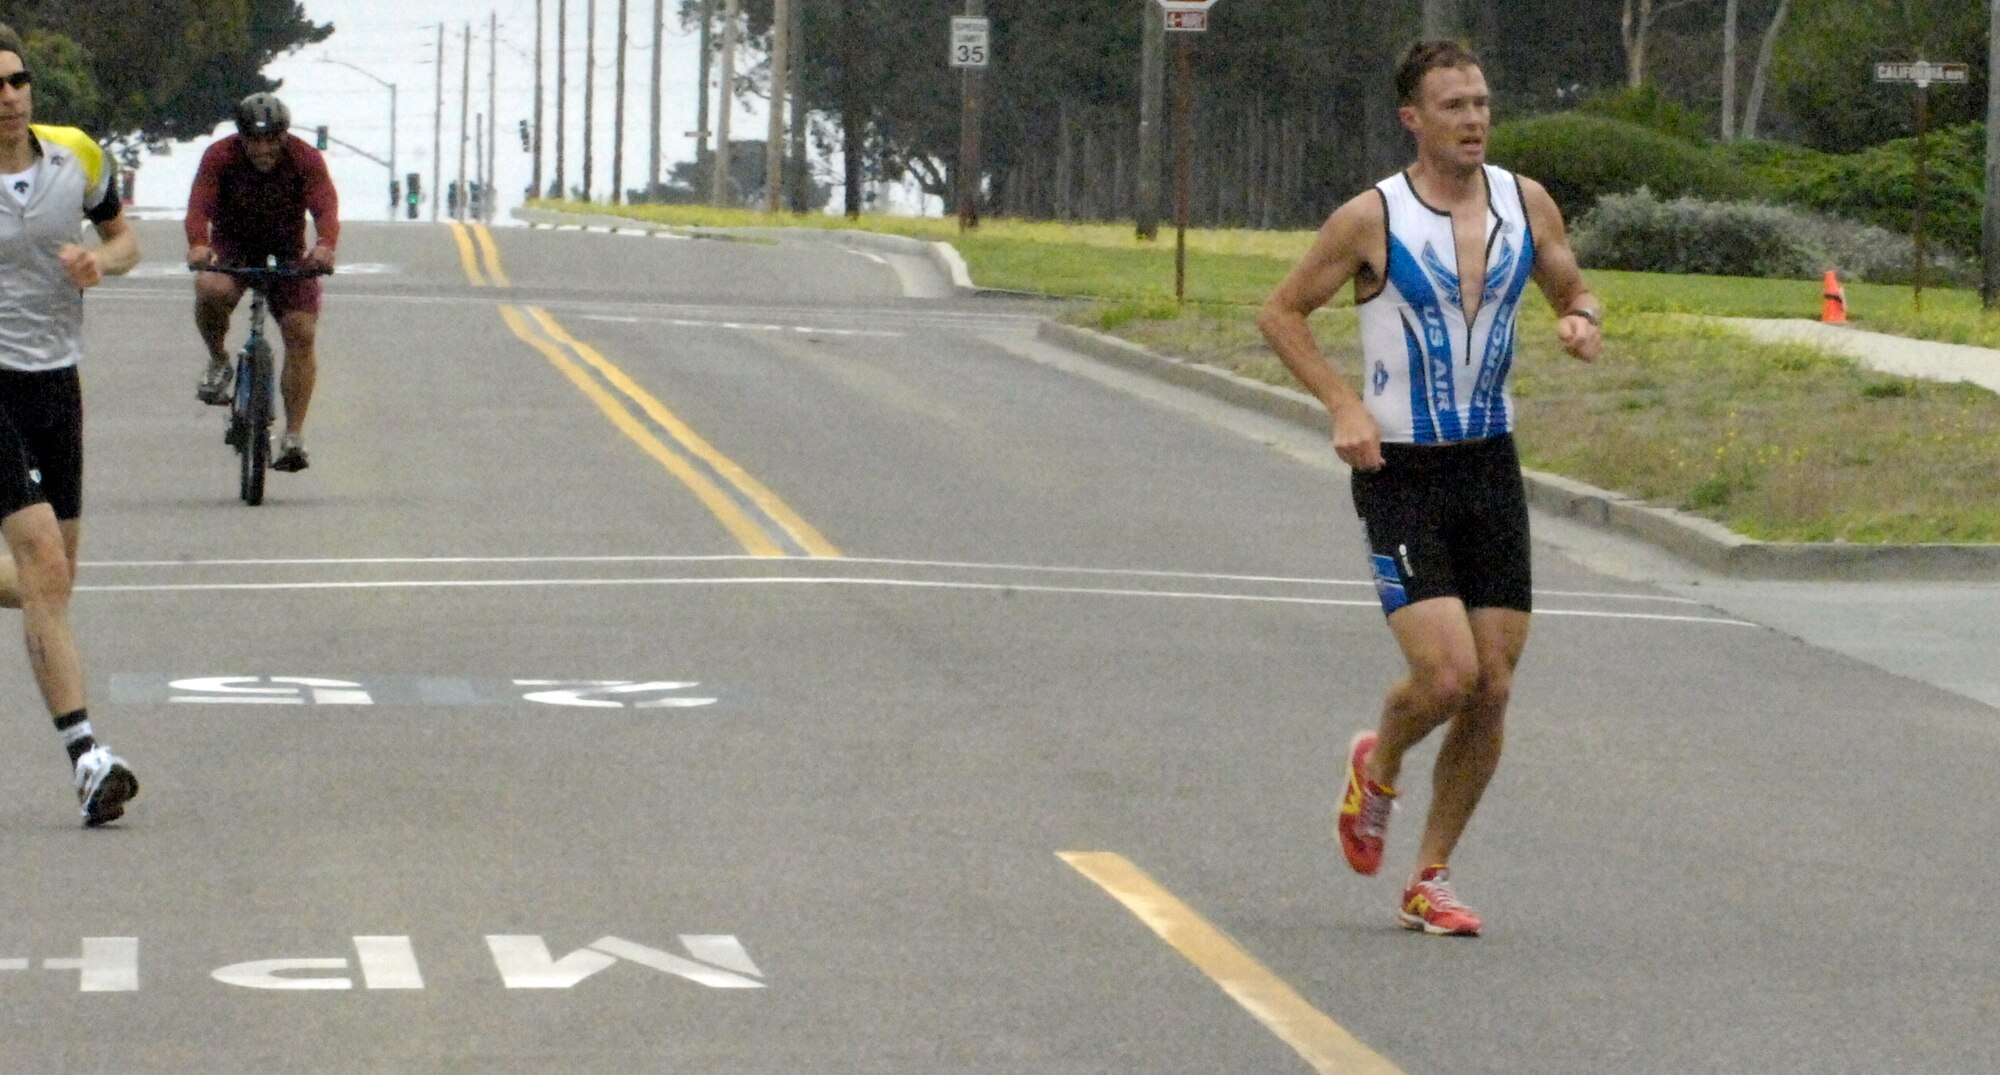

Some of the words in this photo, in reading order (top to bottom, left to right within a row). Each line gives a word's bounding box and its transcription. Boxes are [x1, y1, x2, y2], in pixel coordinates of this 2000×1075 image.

[957, 45, 985, 63] 35
[1423, 305, 1445, 348] US
[1432, 358, 1452, 411] AIR
